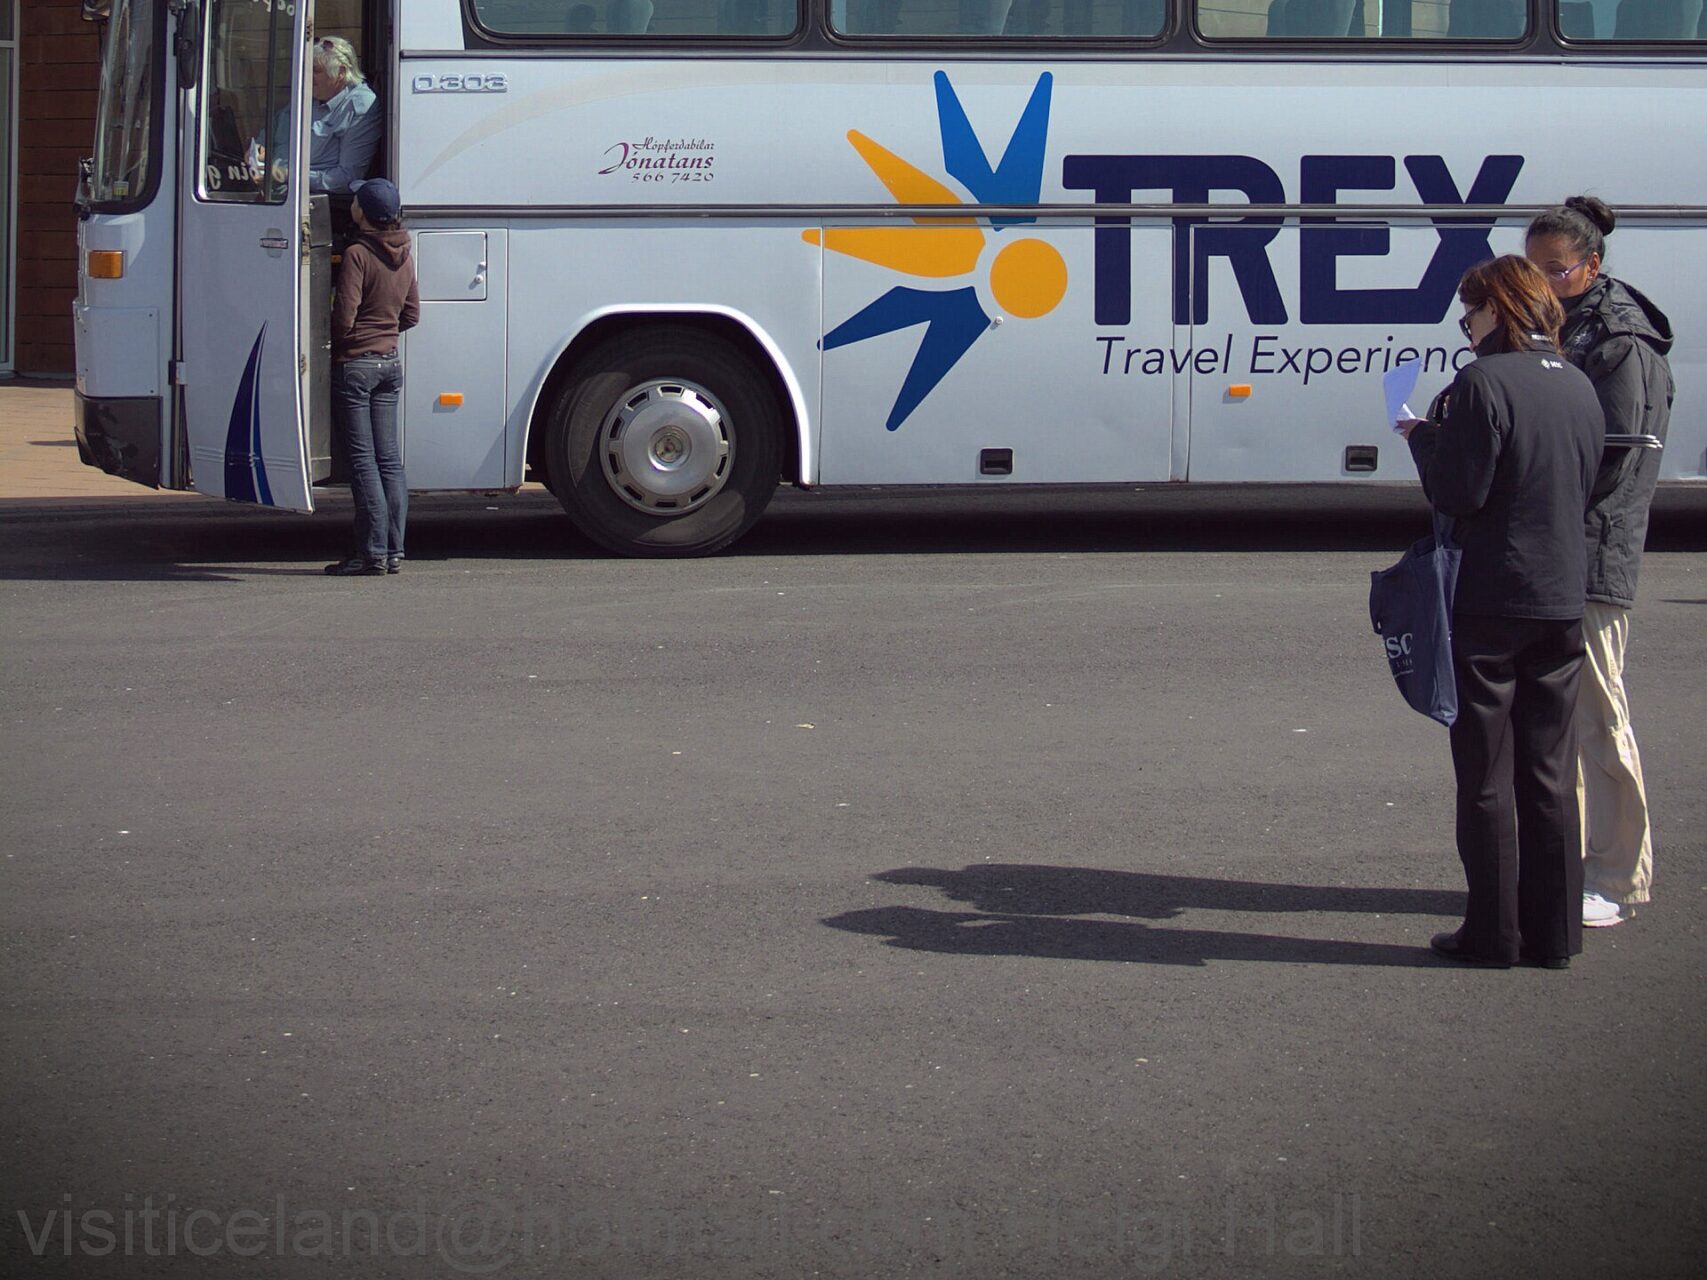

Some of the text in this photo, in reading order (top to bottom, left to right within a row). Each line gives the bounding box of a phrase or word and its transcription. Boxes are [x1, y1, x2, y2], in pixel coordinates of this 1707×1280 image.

[598, 142, 715, 175] Jónatans
[631, 172, 715, 184] 566 7420
[1063, 154, 1525, 326] TREX
[1096, 333, 1472, 386] Travel Experienc
[1385, 632, 1414, 659] SC
